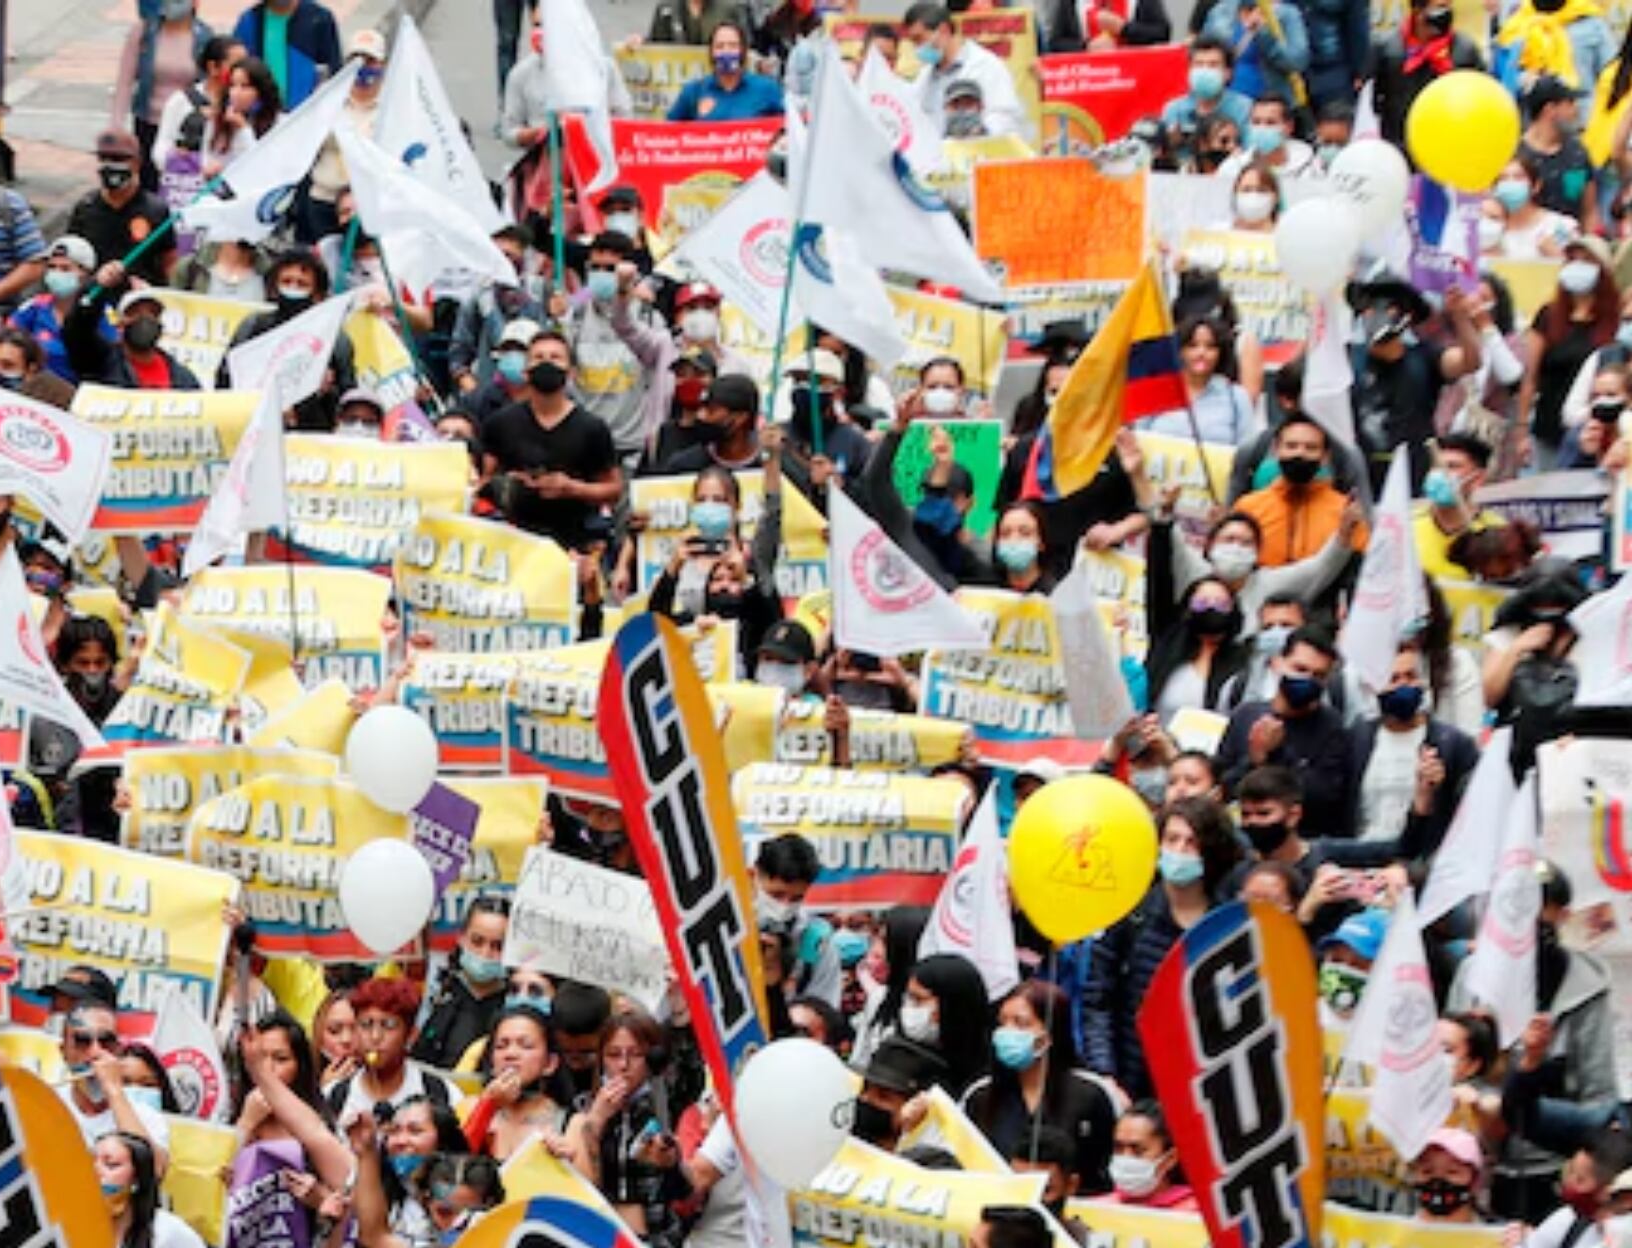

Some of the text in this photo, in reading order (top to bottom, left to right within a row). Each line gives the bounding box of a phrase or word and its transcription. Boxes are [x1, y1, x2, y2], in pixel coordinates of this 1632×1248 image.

[112, 426, 220, 457] EFORMA
[336, 458, 356, 486] A
[367, 458, 404, 488] LA
[441, 538, 464, 574] A
[472, 548, 508, 585] LA
[191, 585, 316, 616] NO A LA
[142, 775, 191, 808] NO
[748, 795, 905, 826] REFORMA
[210, 792, 334, 844] NO A LA
[629, 640, 753, 1034] CUT
[23, 858, 151, 915] NO A LA
[12, 909, 167, 965] REFORMA
[857, 1175, 949, 1216] A LA
